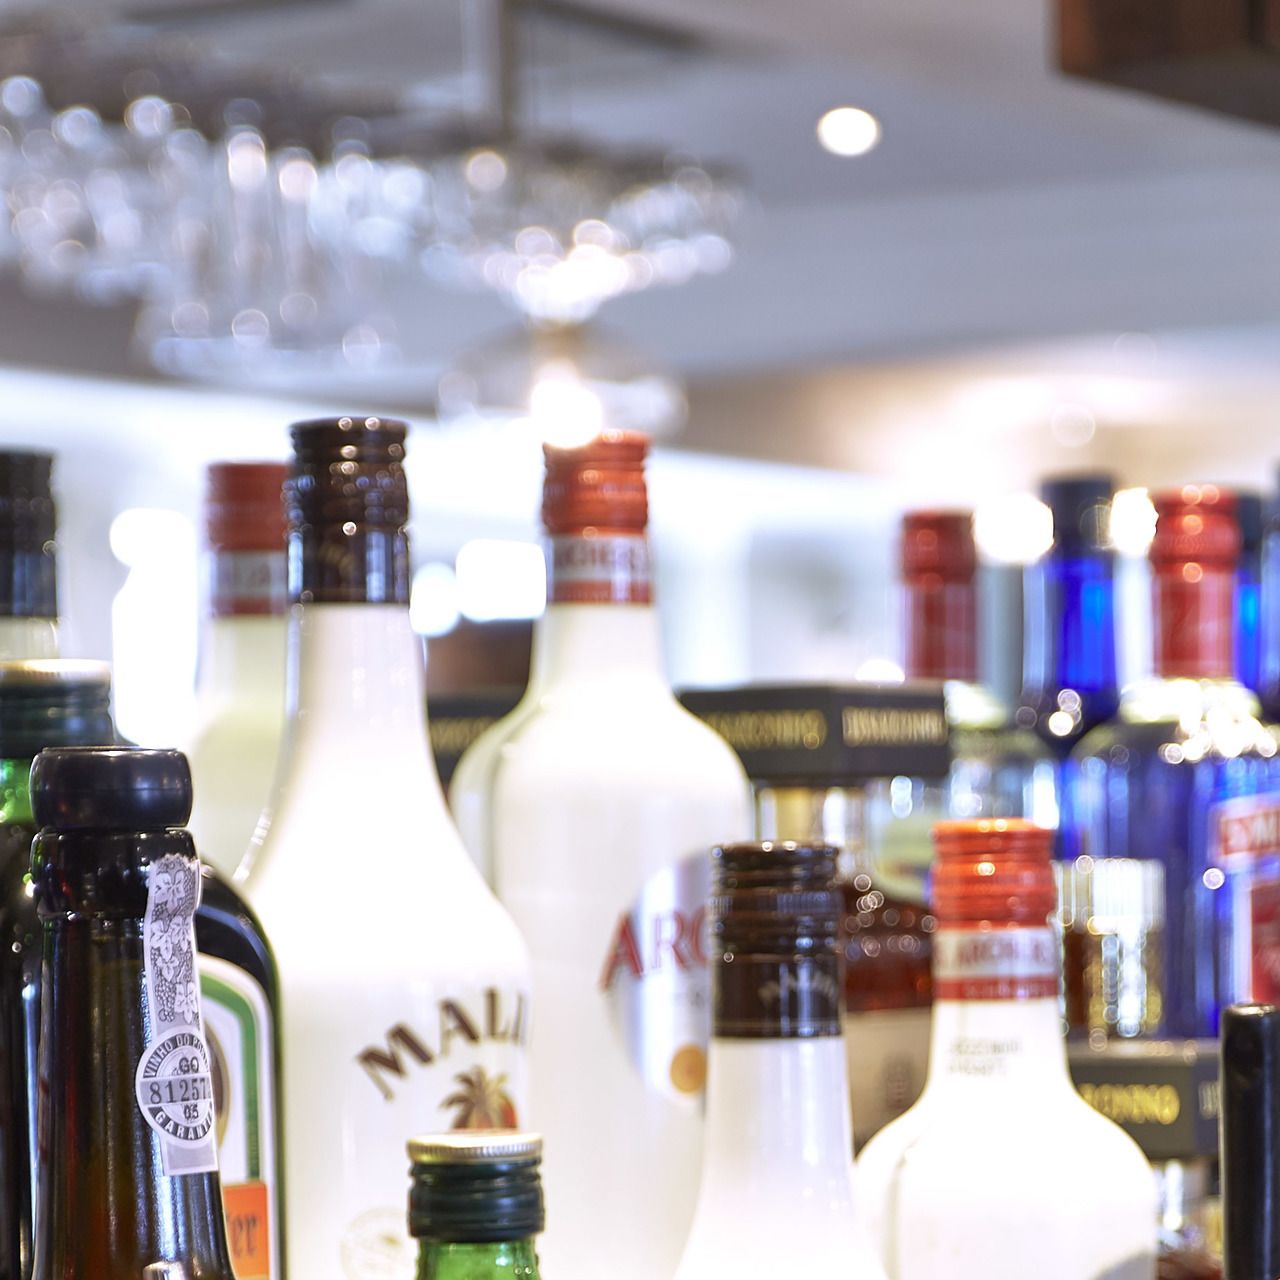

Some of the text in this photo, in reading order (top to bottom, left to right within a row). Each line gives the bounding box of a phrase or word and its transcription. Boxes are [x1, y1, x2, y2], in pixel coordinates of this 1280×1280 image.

[144, 1041, 173, 1077] VINHO
[176, 1035, 190, 1047] DO
[149, 1078, 211, 1104] 81257
